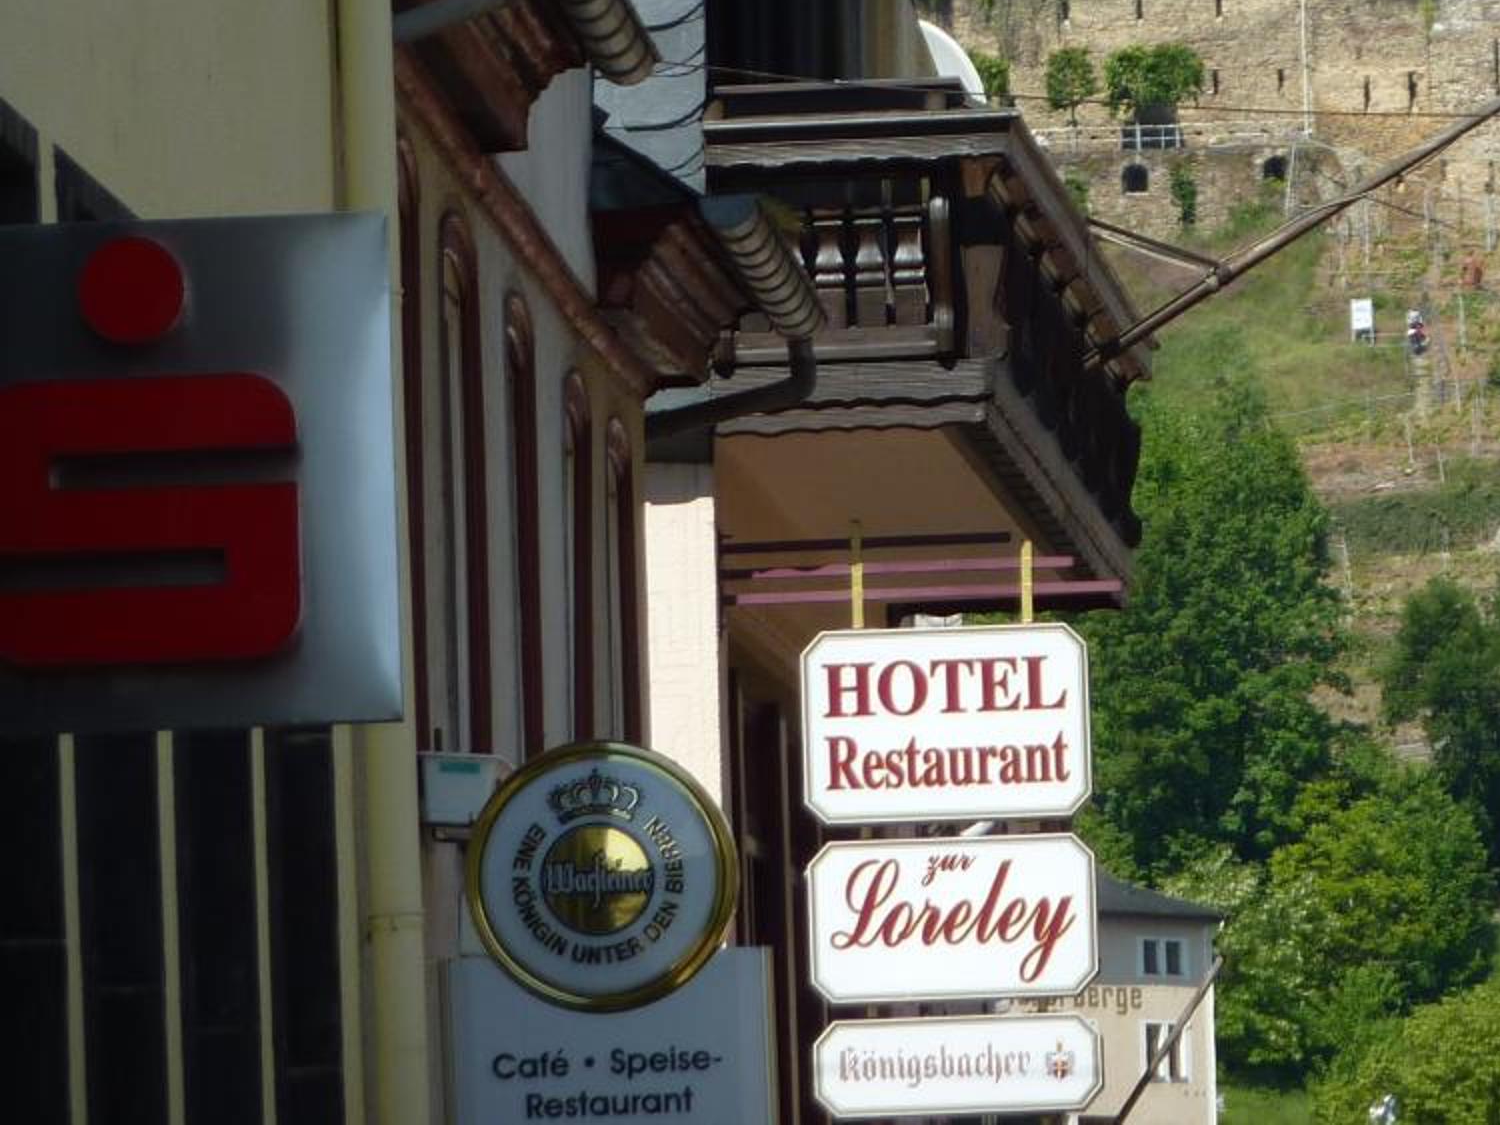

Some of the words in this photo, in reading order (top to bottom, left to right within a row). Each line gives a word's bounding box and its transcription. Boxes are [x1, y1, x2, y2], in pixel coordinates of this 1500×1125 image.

[822, 656, 1067, 718] HOTEL
[824, 731, 1070, 791] Restaurant
[512, 823, 545, 871] EINE
[921, 852, 976, 886] zur
[512, 876, 568, 956] KÖNIGIN
[643, 899, 679, 943] DEN
[830, 859, 1077, 983] Loreley
[571, 934, 645, 965] UNTER
[492, 1048, 570, 1079] Café
[610, 1045, 723, 1079] Speise-
[839, 1044, 1031, 1088] Königsbacher
[526, 1086, 694, 1118] Restaurant
